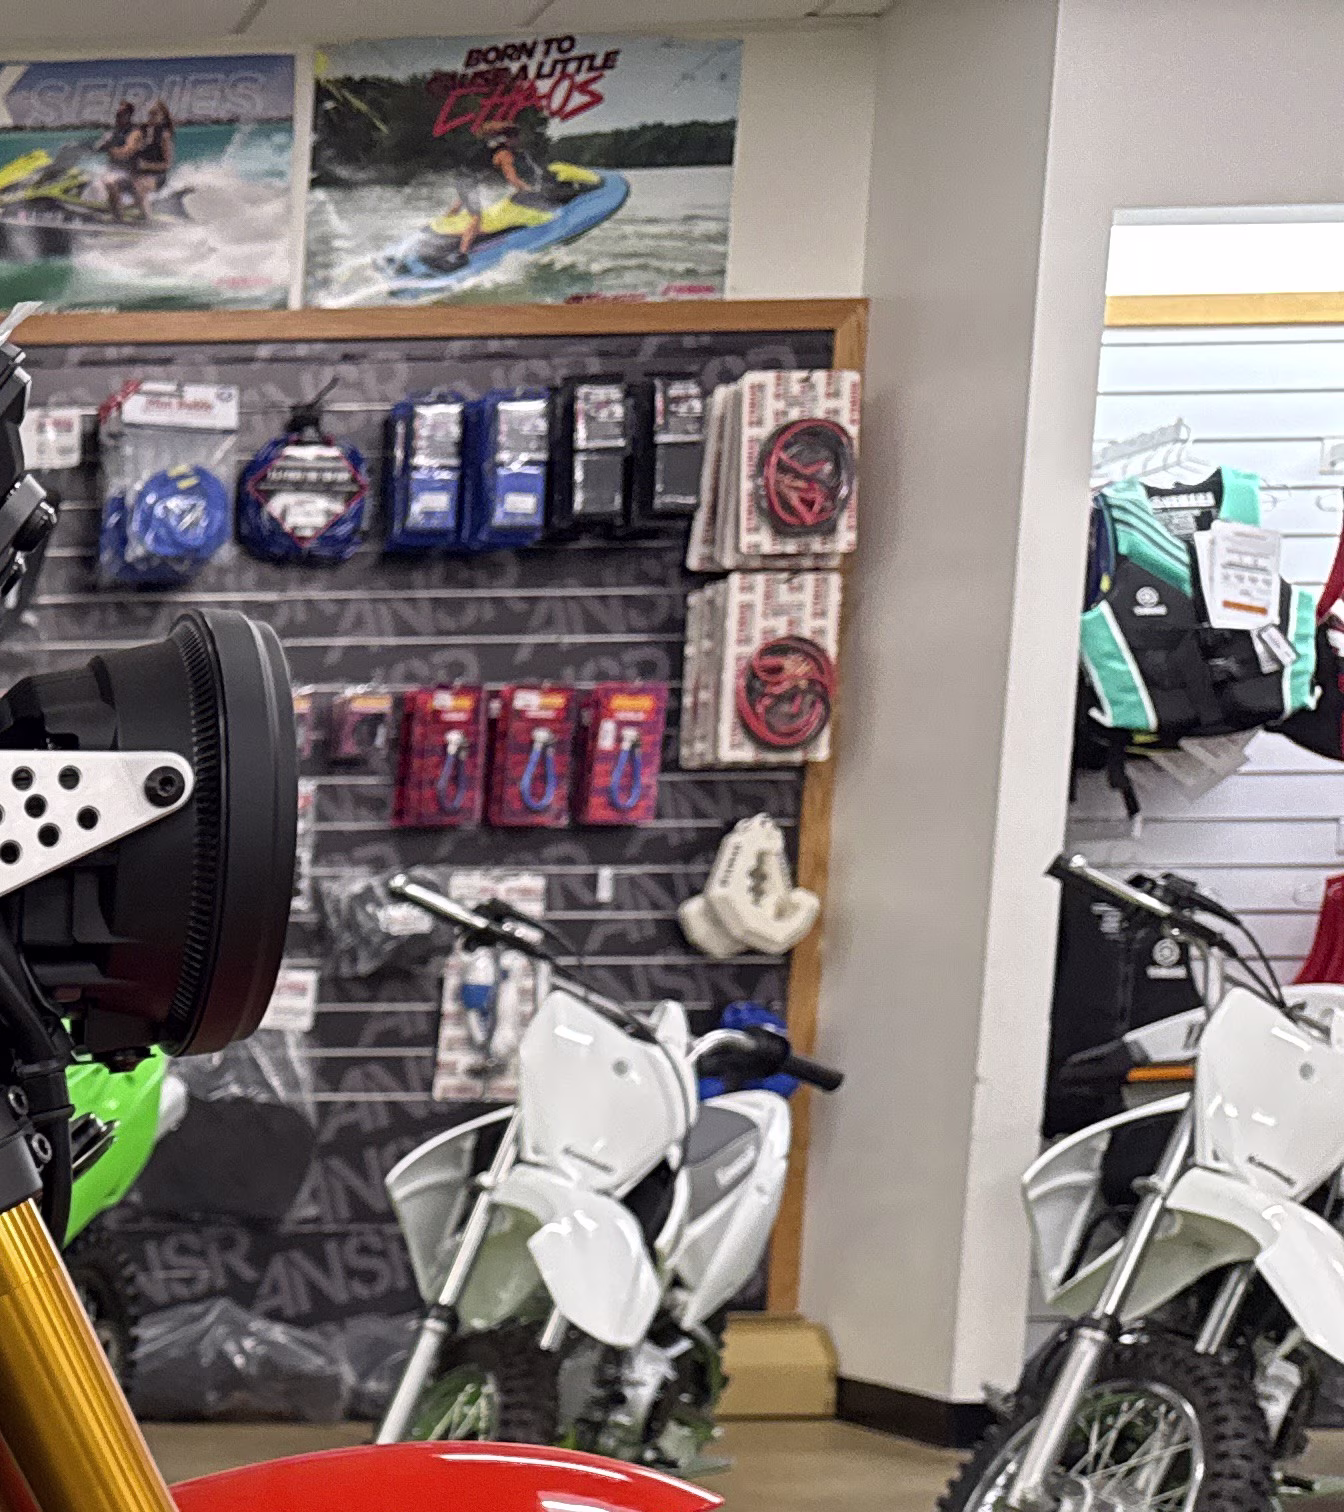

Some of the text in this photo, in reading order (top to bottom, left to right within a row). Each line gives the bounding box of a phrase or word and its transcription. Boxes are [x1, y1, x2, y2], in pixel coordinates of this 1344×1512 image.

[465, 35, 576, 68] BORN TO
[536, 49, 621, 79] LITTLE
[30, 72, 267, 126] SERIES
